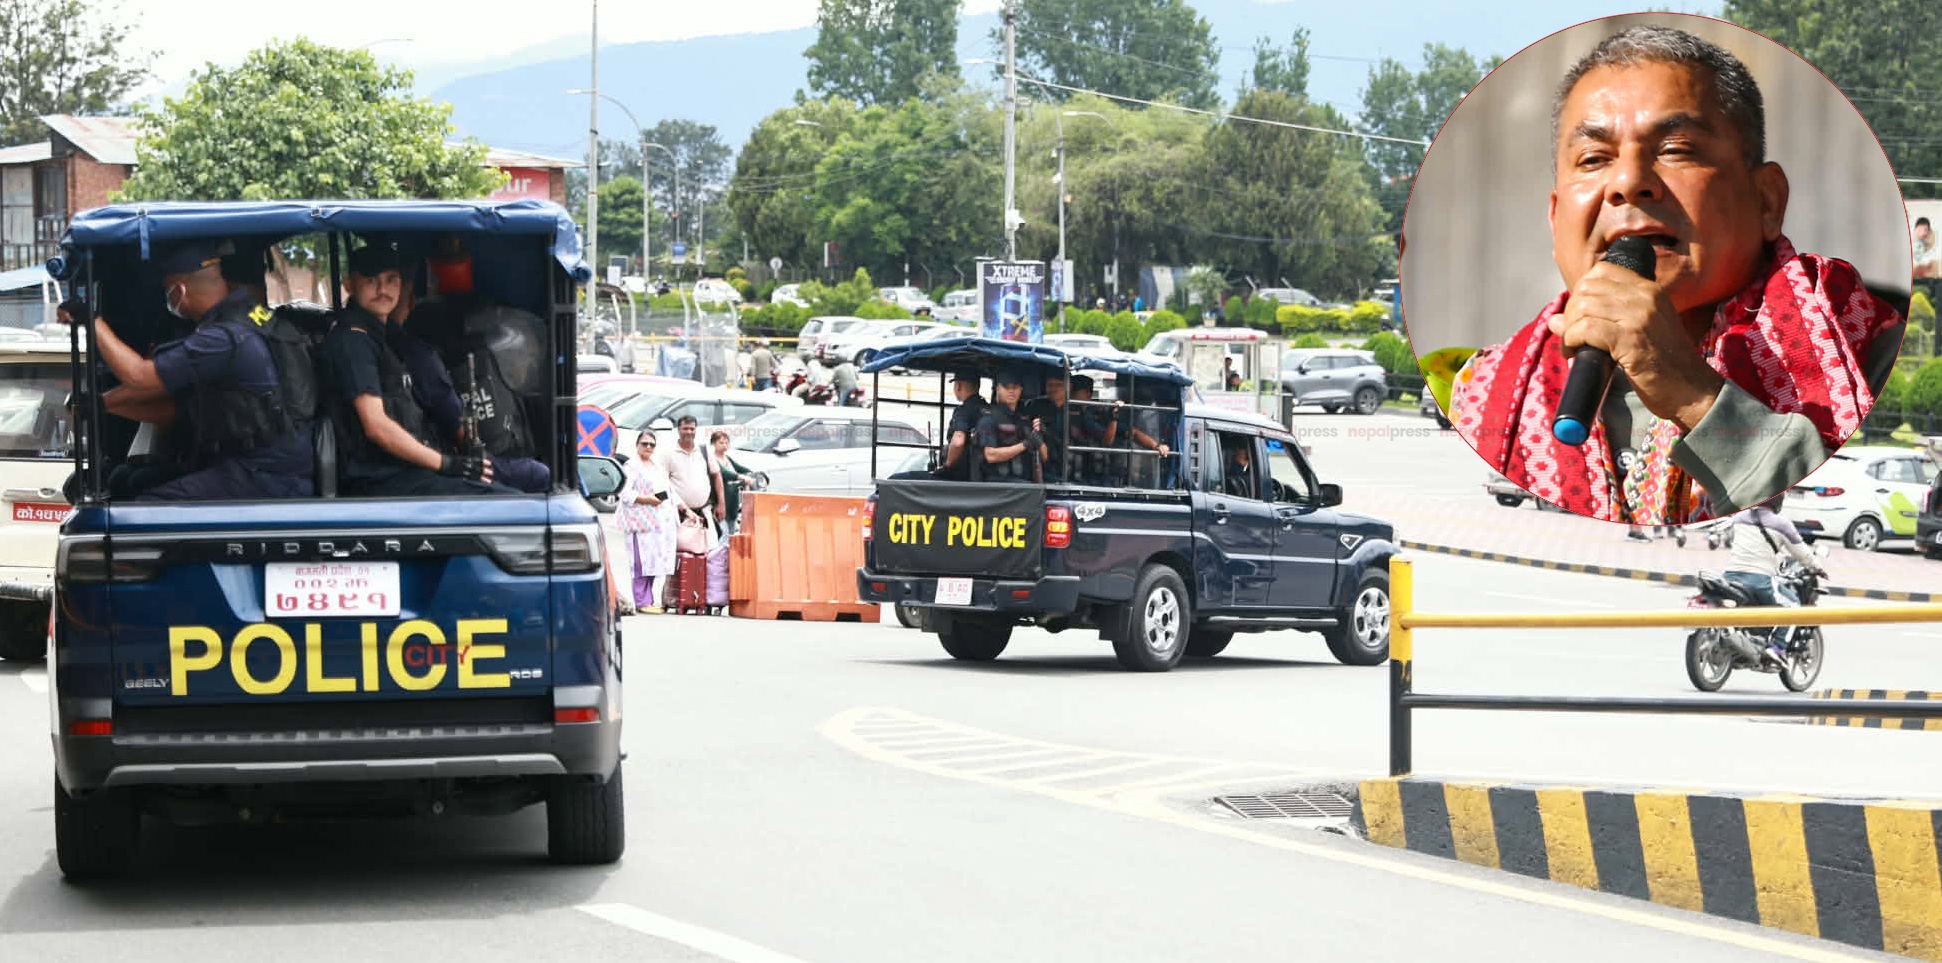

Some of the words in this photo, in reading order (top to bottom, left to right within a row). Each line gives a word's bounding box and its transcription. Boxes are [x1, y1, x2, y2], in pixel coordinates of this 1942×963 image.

[992, 265, 1036, 278] XTREME
[889, 513, 936, 545] CITY
[947, 516, 1027, 548] POLICE
[227, 539, 435, 555] RIDDARA
[169, 618, 511, 696] POLICE
[404, 643, 472, 667] CITY
